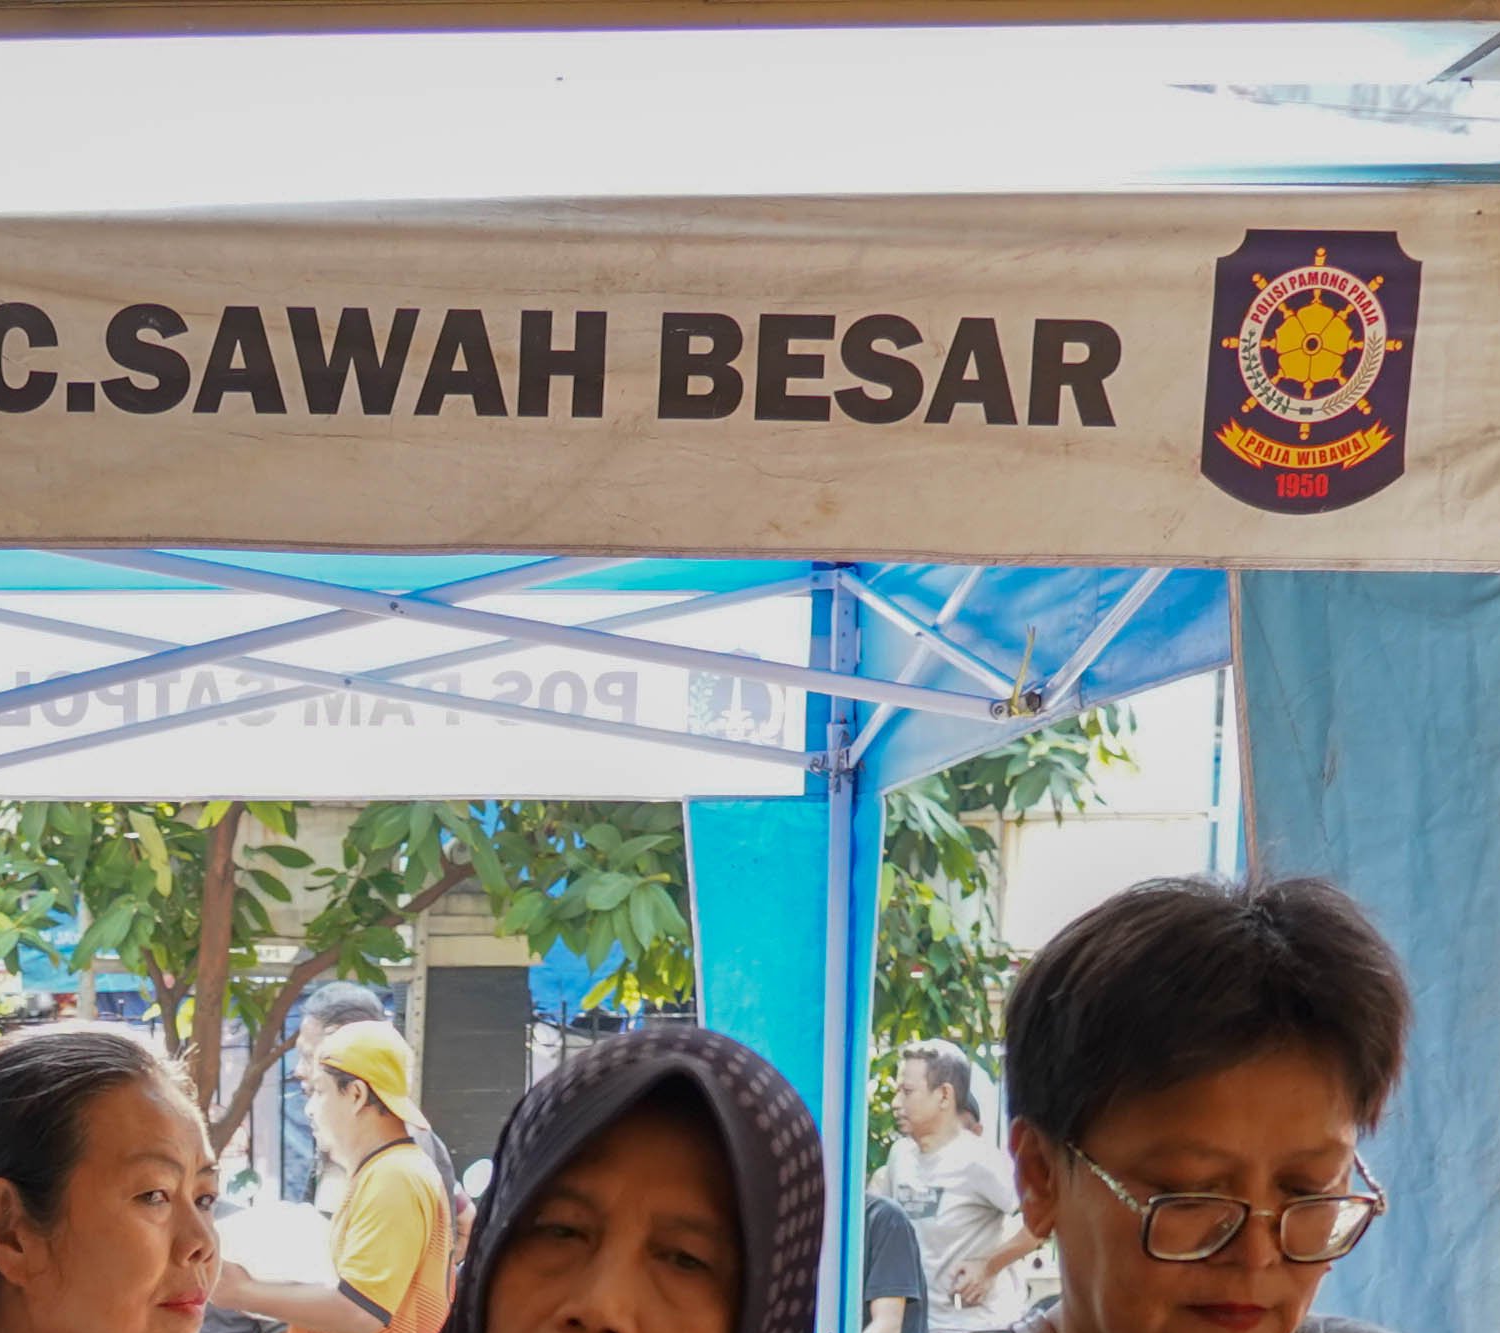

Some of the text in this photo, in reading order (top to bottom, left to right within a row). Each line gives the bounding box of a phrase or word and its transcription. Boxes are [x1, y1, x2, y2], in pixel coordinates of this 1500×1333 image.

[1250, 271, 1381, 327] POLISI PAMONG PRAJA
[657, 311, 1121, 428] BESAR
[1244, 435, 1363, 466] PRAJA WIBAWA
[1275, 472, 1329, 498] 1950
